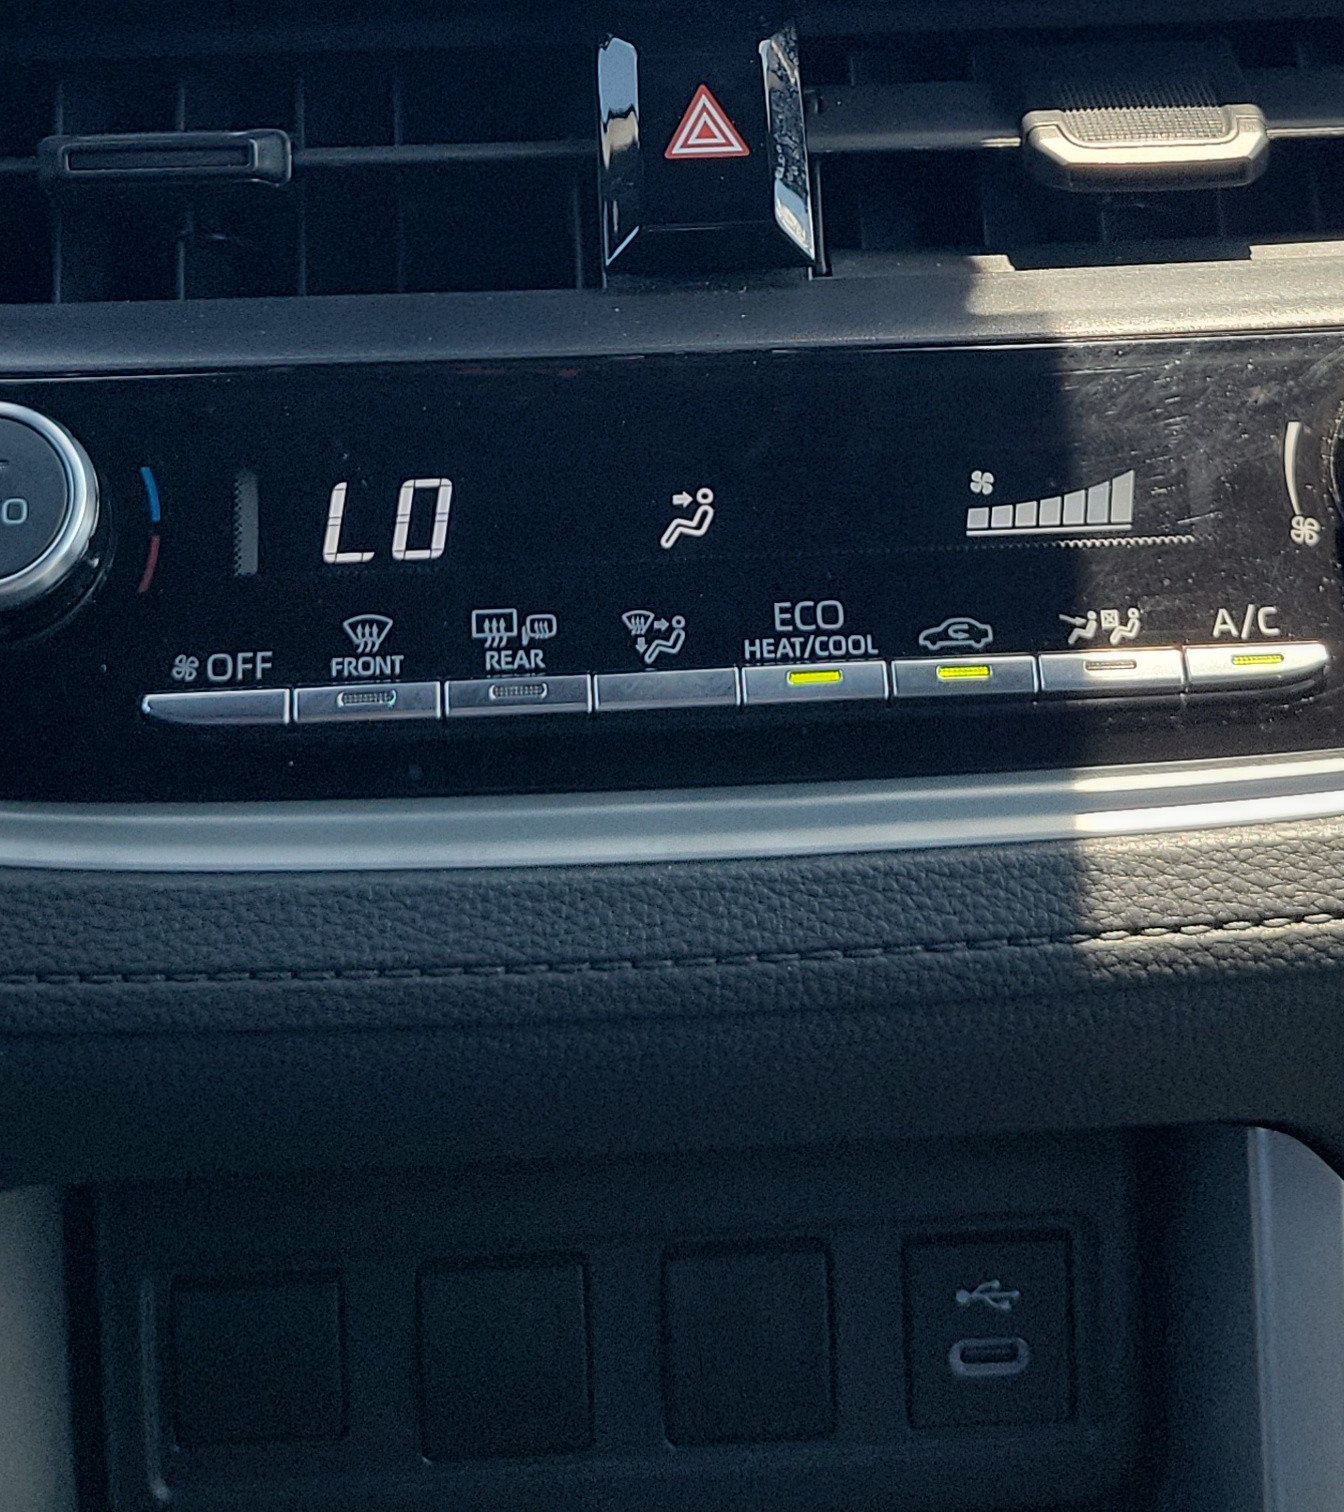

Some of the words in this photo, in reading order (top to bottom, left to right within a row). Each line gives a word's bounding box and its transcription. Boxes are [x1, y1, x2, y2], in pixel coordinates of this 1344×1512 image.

[773, 599, 845, 632] ECO
[1212, 605, 1283, 640] A/C
[484, 648, 547, 672] REAR
[743, 633, 880, 662] HEAT/COOL
[207, 651, 274, 682] OFF
[330, 654, 405, 678] FRONT
